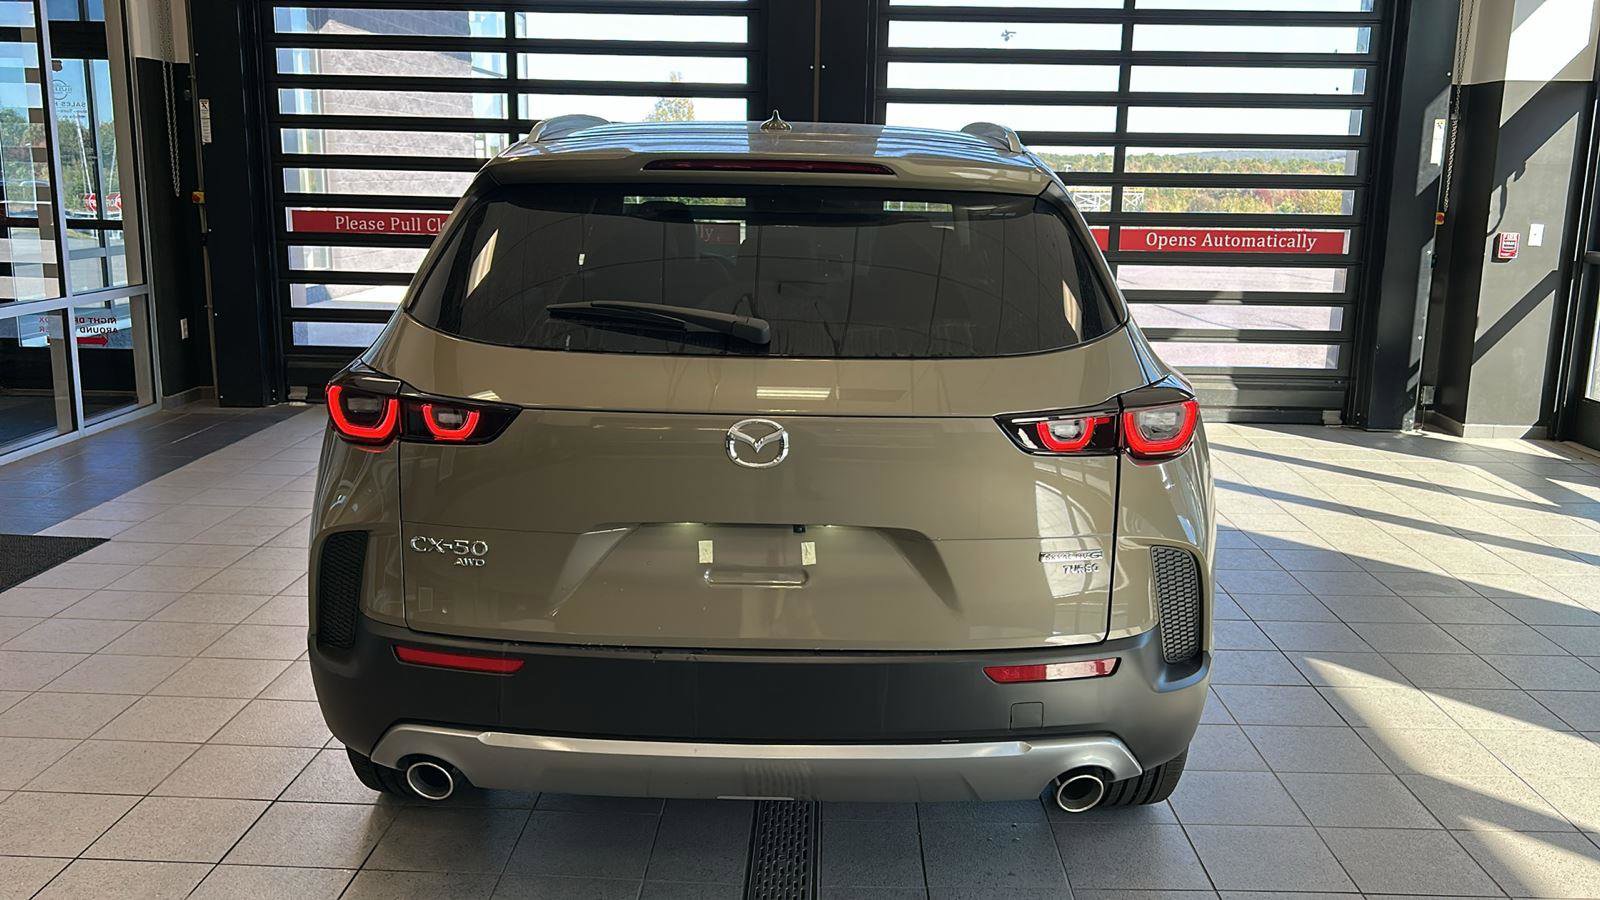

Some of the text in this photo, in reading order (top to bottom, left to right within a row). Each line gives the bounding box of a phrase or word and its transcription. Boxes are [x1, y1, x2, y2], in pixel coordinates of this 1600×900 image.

[335, 216, 385, 230] Please
[390, 217, 421, 231] Pull
[1146, 232, 1317, 251] Opens Automatically
[410, 535, 488, 556] CX-50
[454, 557, 486, 567] AWD
